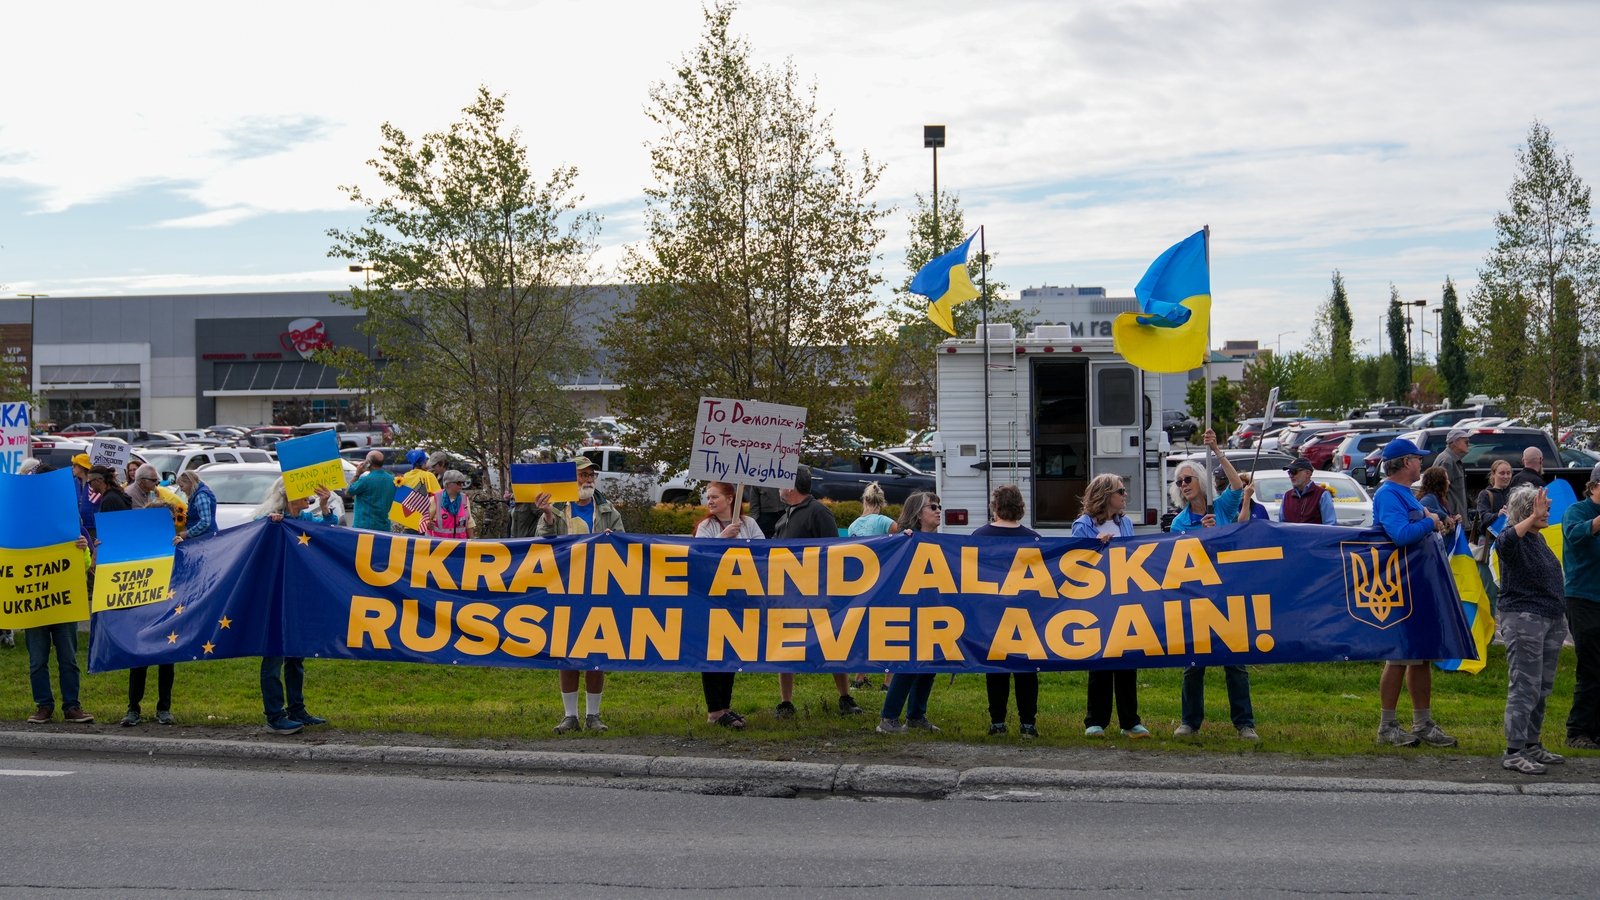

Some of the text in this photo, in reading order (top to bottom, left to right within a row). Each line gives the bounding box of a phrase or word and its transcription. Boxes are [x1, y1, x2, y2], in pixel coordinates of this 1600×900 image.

[1090, 320, 1112, 336] ra
[0, 403, 28, 427] KA
[704, 400, 726, 422] To
[795, 418, 805, 430] is
[7, 435, 28, 446] WITH
[701, 425, 716, 446] to
[100, 442, 116, 450] FEAR
[289, 463, 342, 483] STAND WITH
[698, 449, 797, 482] Thy Neighbor
[296, 476, 339, 493] UKRAINE
[24, 558, 71, 578] STAND
[354, 533, 690, 597] UKRAINE
[708, 545, 881, 596] AND
[111, 568, 154, 583] STAND
[118, 579, 149, 592] WITH
[15, 581, 49, 594] WITH
[106, 586, 165, 607] UKRAINE
[3, 590, 72, 614] UKRAINE
[346, 594, 1276, 662] RUSSIAN NEVER AGAIN!
